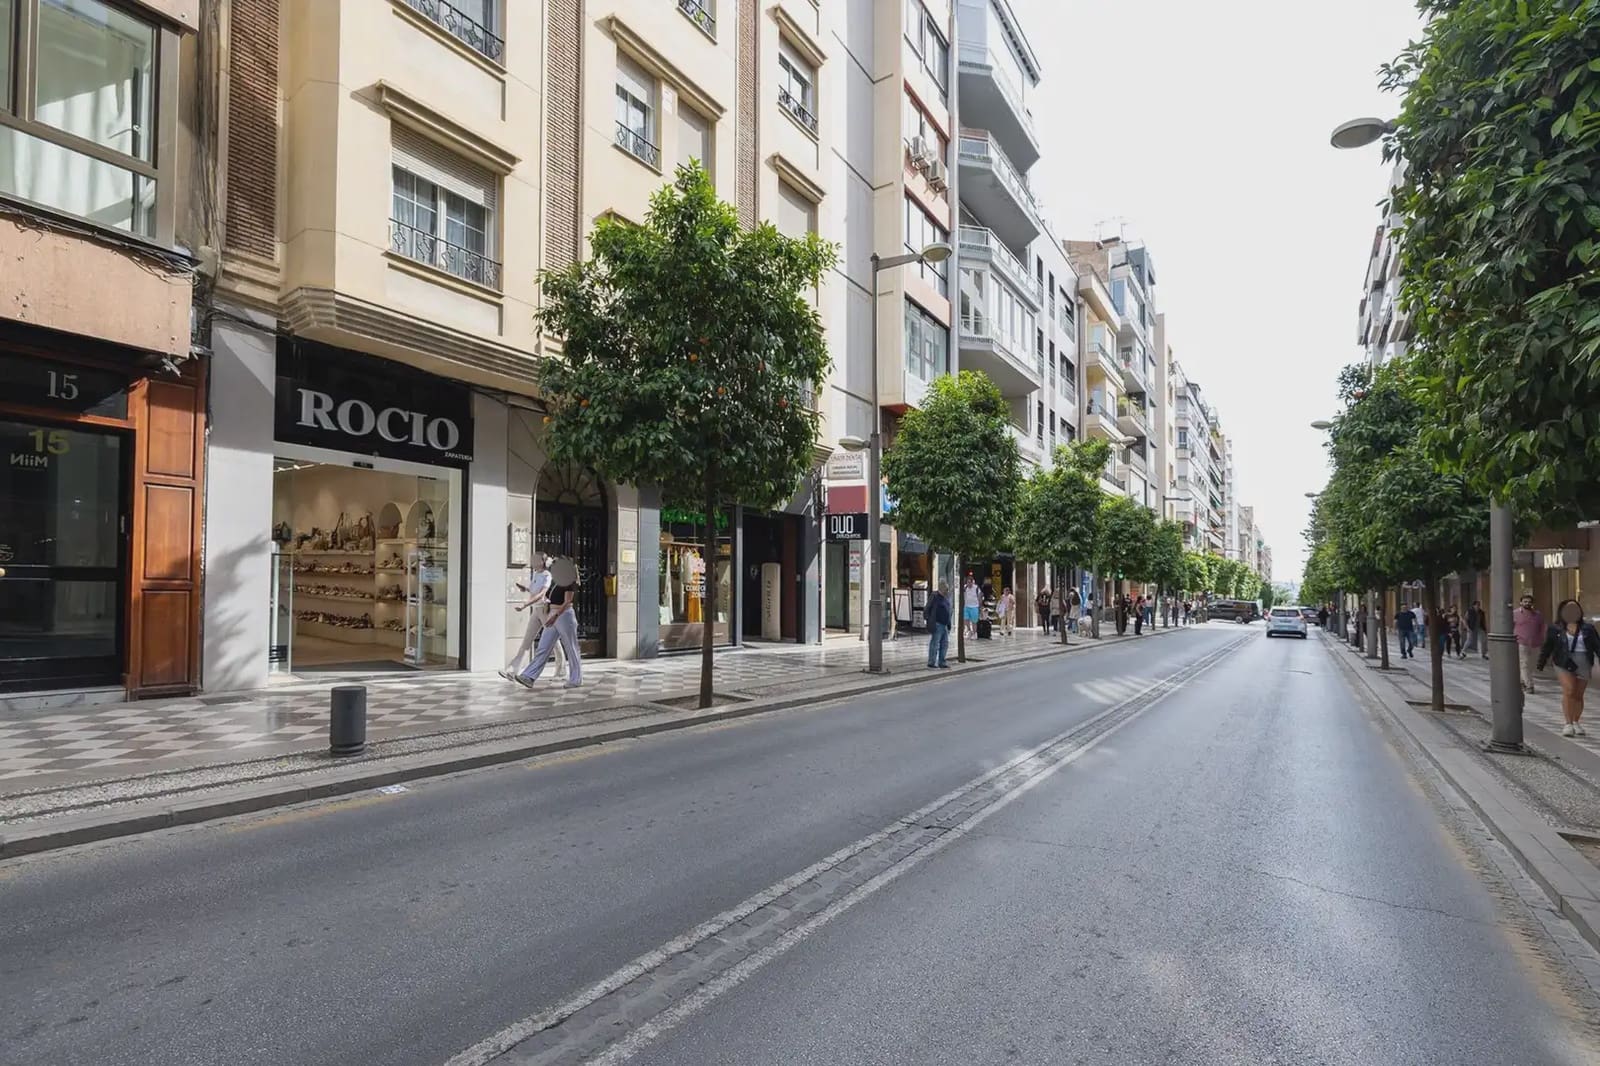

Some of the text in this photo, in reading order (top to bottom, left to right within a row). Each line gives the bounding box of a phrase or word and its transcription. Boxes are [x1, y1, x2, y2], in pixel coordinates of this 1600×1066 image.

[47, 370, 79, 400] 15
[296, 388, 460, 451] ROCIO
[28, 429, 71, 455] 15
[831, 515, 854, 534] DUO
